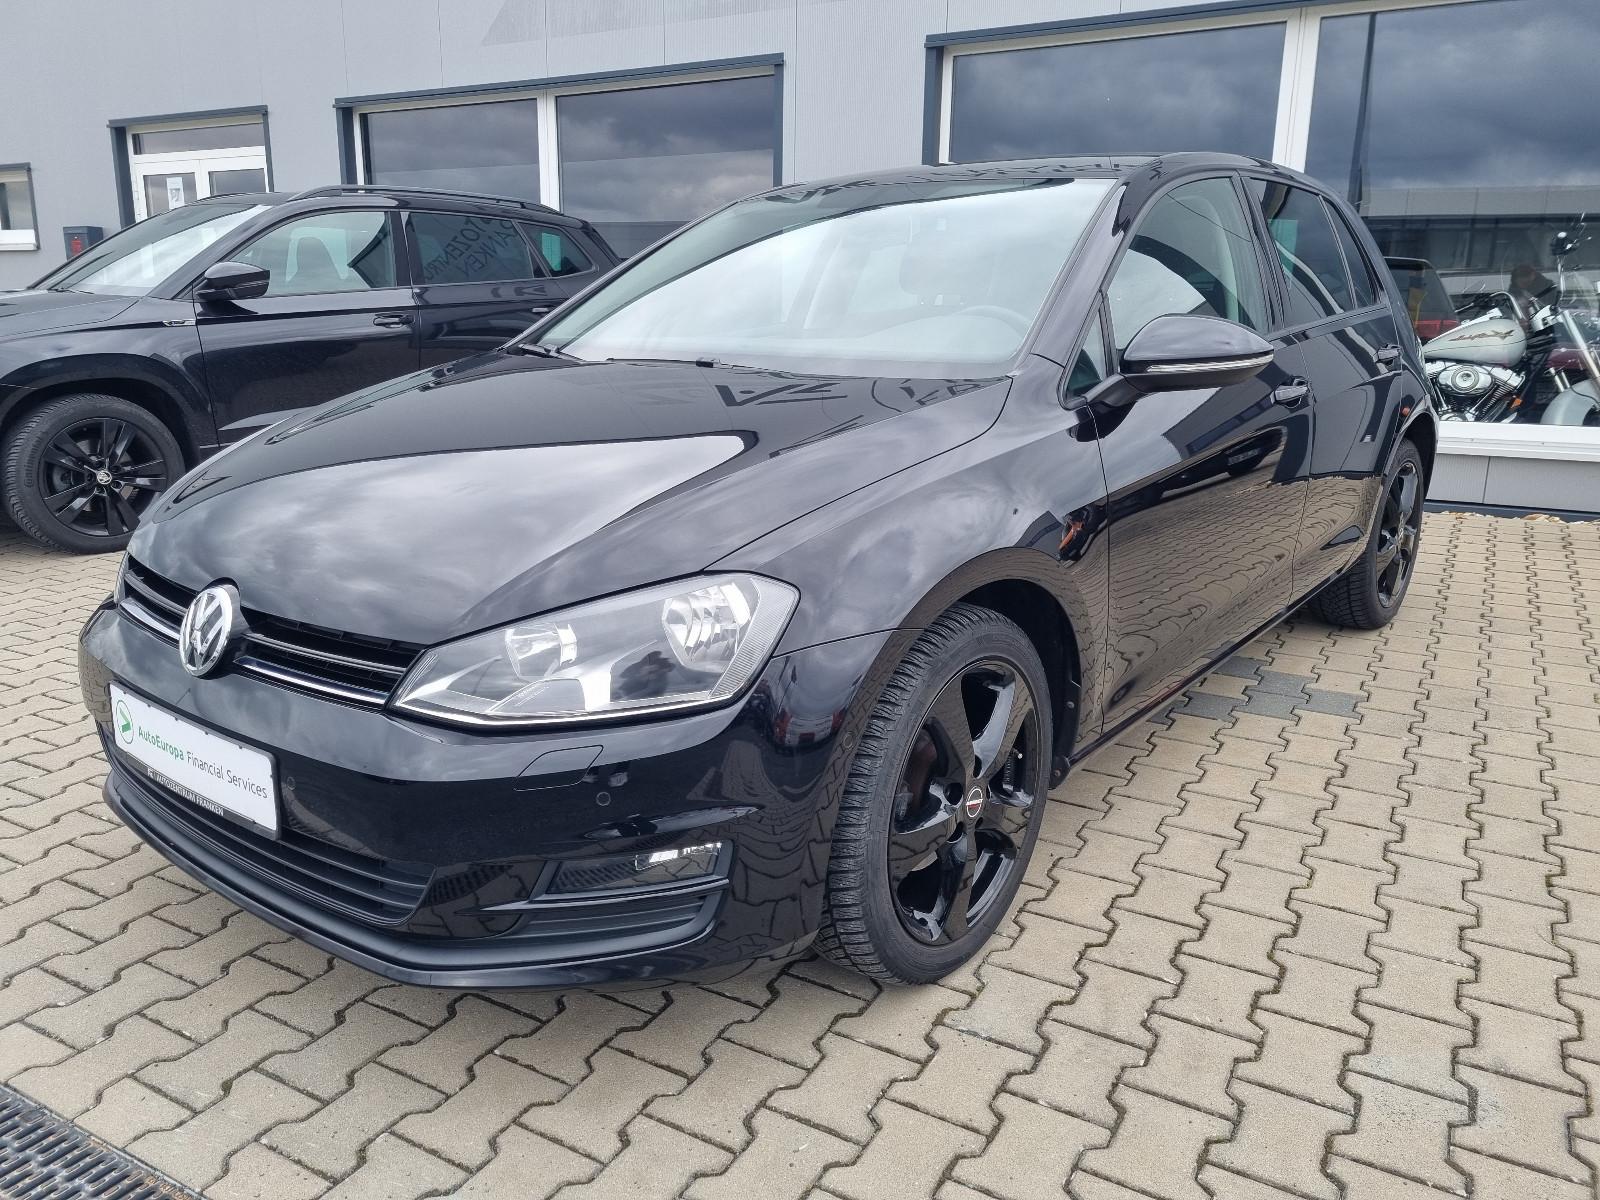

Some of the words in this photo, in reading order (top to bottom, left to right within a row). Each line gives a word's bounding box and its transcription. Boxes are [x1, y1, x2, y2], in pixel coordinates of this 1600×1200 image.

[182, 589, 230, 674] VW
[138, 726, 185, 761] AutoEuropa
[187, 751, 224, 780] Financial
[226, 769, 268, 799] Services
